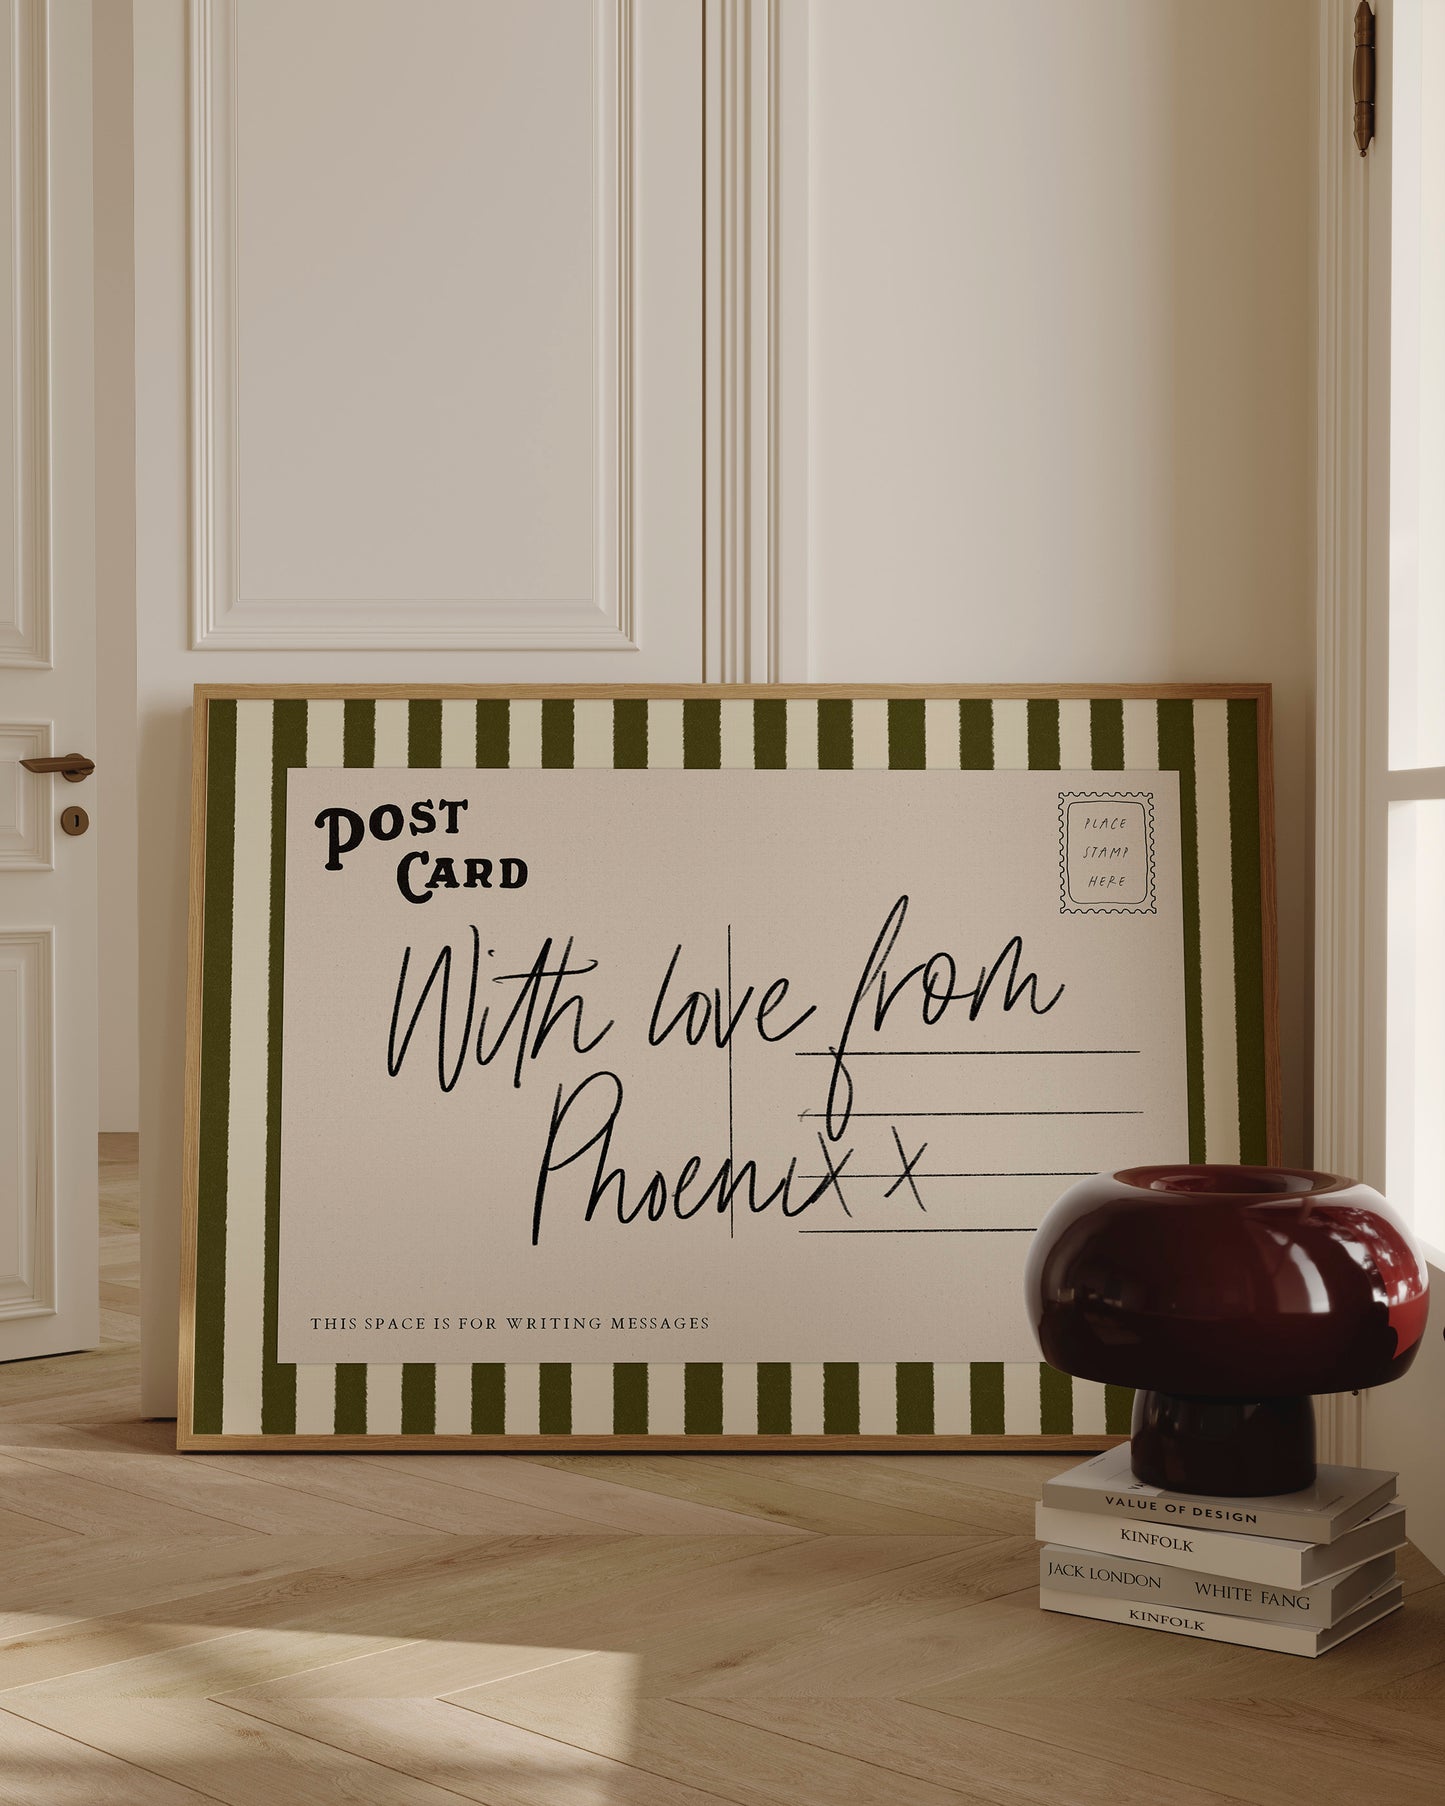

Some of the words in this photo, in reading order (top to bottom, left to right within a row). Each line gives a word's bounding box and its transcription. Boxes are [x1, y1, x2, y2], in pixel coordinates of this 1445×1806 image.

[314, 799, 469, 871] POST
[1084, 817, 1127, 830] PLACE
[1083, 846, 1129, 859] STAMP
[396, 850, 529, 905] CARD
[1088, 875, 1126, 888] HERE
[387, 924, 615, 1093] With
[648, 943, 817, 1048] love
[827, 894, 1066, 1142] from
[310, 1317, 358, 1329] THIS
[364, 1316, 426, 1329] SPACE
[433, 1316, 451, 1329] IS
[458, 1316, 497, 1329] FOR
[506, 1316, 602, 1329] WRITING
[611, 1315, 710, 1329] MESSAGES
[1105, 1496, 1157, 1511] VALUE
[1165, 1503, 1186, 1515] OF
[1193, 1507, 1257, 1524] DESIGN
[1120, 1528, 1194, 1553] KINFOLK
[1047, 1561, 1085, 1580] JACK
[1089, 1567, 1162, 1589] LONDON
[1194, 1581, 1252, 1603] WHITE
[1260, 1590, 1311, 1612] FANG
[1129, 1609, 1205, 1632] KINFOLK
